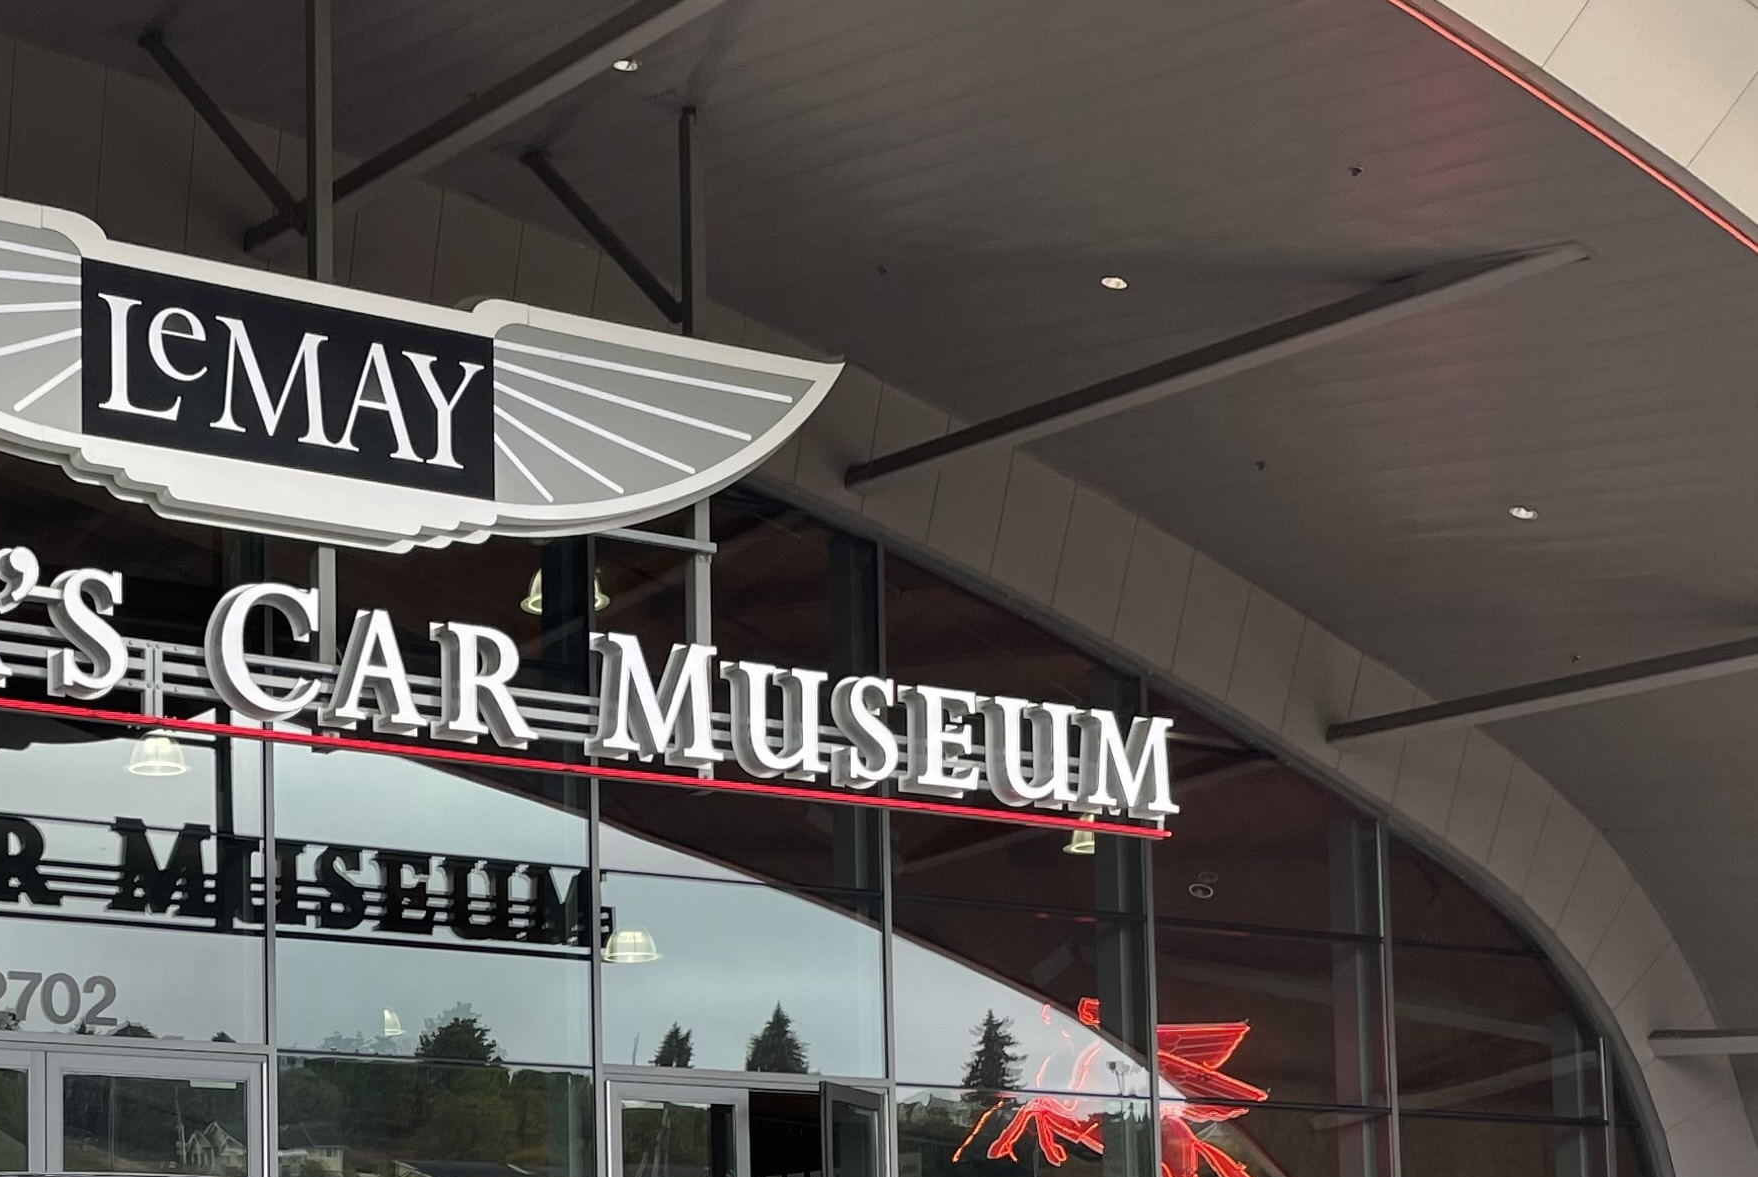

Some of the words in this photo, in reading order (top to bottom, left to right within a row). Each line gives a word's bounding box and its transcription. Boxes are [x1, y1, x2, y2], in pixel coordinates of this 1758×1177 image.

[98, 293, 484, 469] LeMAY
[204, 582, 540, 749] CAR
[584, 632, 1180, 820] MUSEUM
